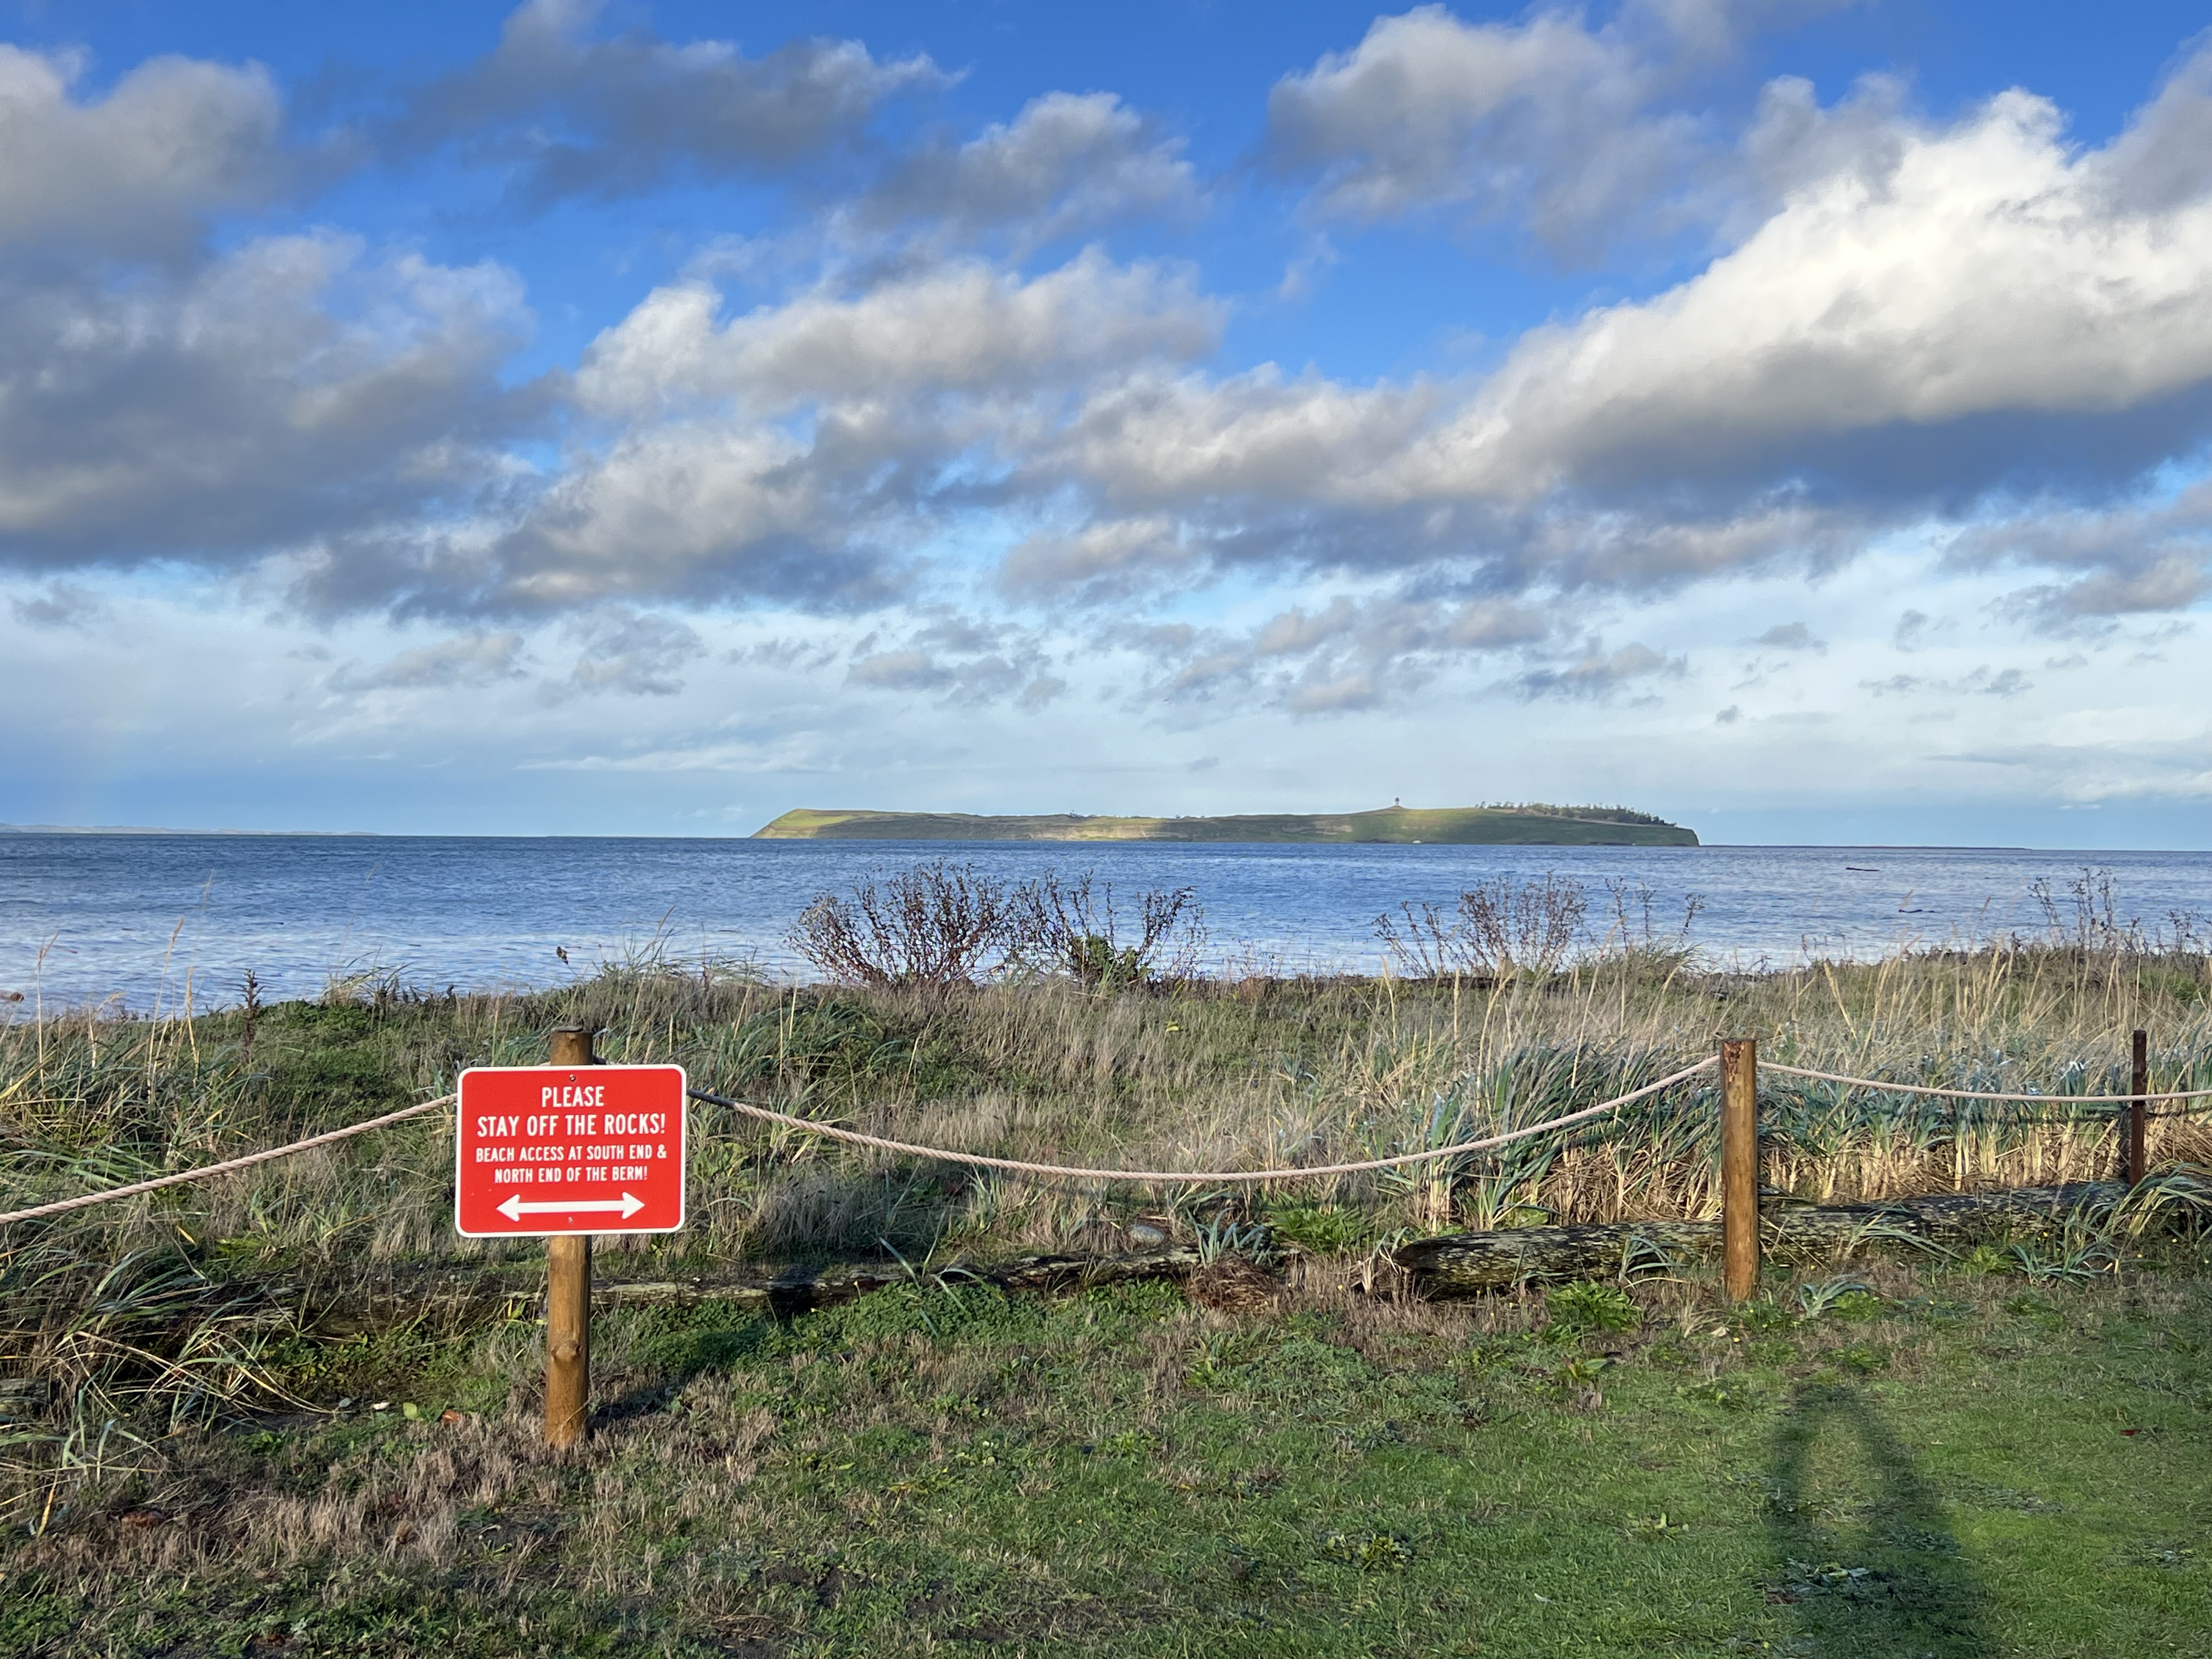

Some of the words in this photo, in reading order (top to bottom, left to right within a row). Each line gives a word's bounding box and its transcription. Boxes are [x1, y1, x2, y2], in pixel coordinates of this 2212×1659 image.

[542, 1086, 604, 1107] PLEASE
[477, 1116, 519, 1137] STAY
[527, 1115, 558, 1136] OFF
[565, 1115, 596, 1135] THE
[605, 1113, 665, 1135] ROCKS!
[476, 1147, 514, 1162] BEACH
[520, 1147, 564, 1161] ACCESS
[568, 1146, 583, 1160] AT
[587, 1145, 624, 1160] SOUTH
[630, 1145, 652, 1159] END
[657, 1144, 667, 1158] &
[495, 1169, 533, 1183] NORTH
[539, 1168, 561, 1182] END
[567, 1167, 582, 1182] OF
[586, 1167, 607, 1181] THE
[612, 1166, 647, 1181] BERM!
